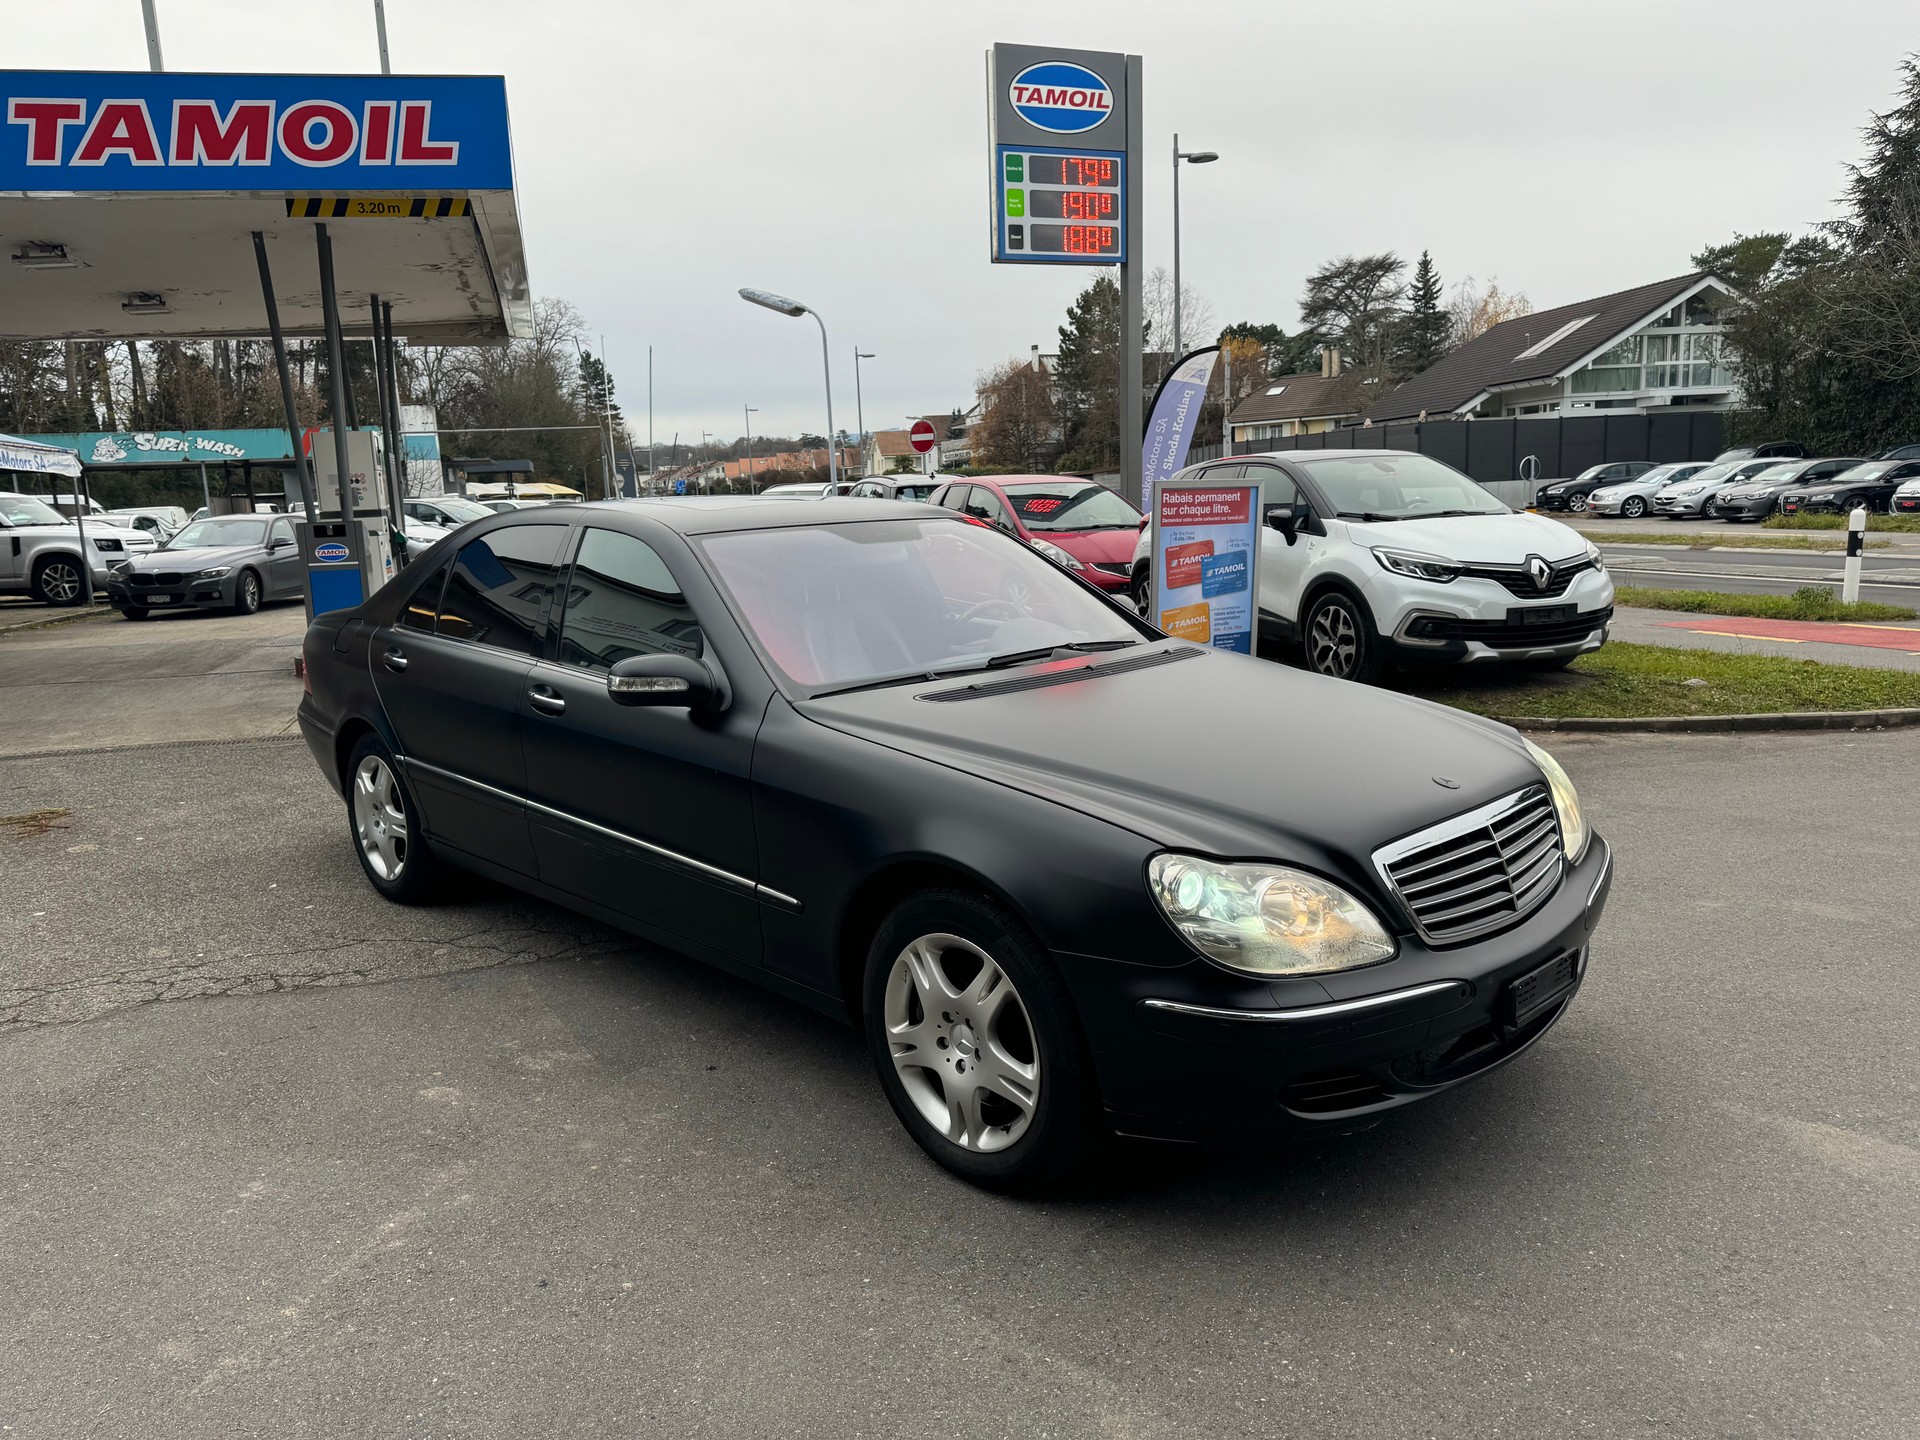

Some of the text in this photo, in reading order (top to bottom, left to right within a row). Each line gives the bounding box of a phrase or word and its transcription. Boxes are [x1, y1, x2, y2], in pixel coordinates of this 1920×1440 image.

[1013, 86, 1110, 109] TAMOIL
[8, 97, 460, 168] TAMOIL
[357, 202, 401, 214] 3.20 m
[1163, 389, 1195, 470] Skoda Kodiaq
[134, 432, 245, 458] SUPER WASH
[33, 454, 47, 471] SA
[1142, 435, 1164, 502] LakeMotors
[1156, 417, 1168, 434] SA
[1162, 492, 1241, 504] Rabais permanent
[1162, 504, 1231, 516] sur chaque litre.
[1214, 563, 1246, 576] TAMOIL
[1175, 615, 1208, 628] TAMOIL
